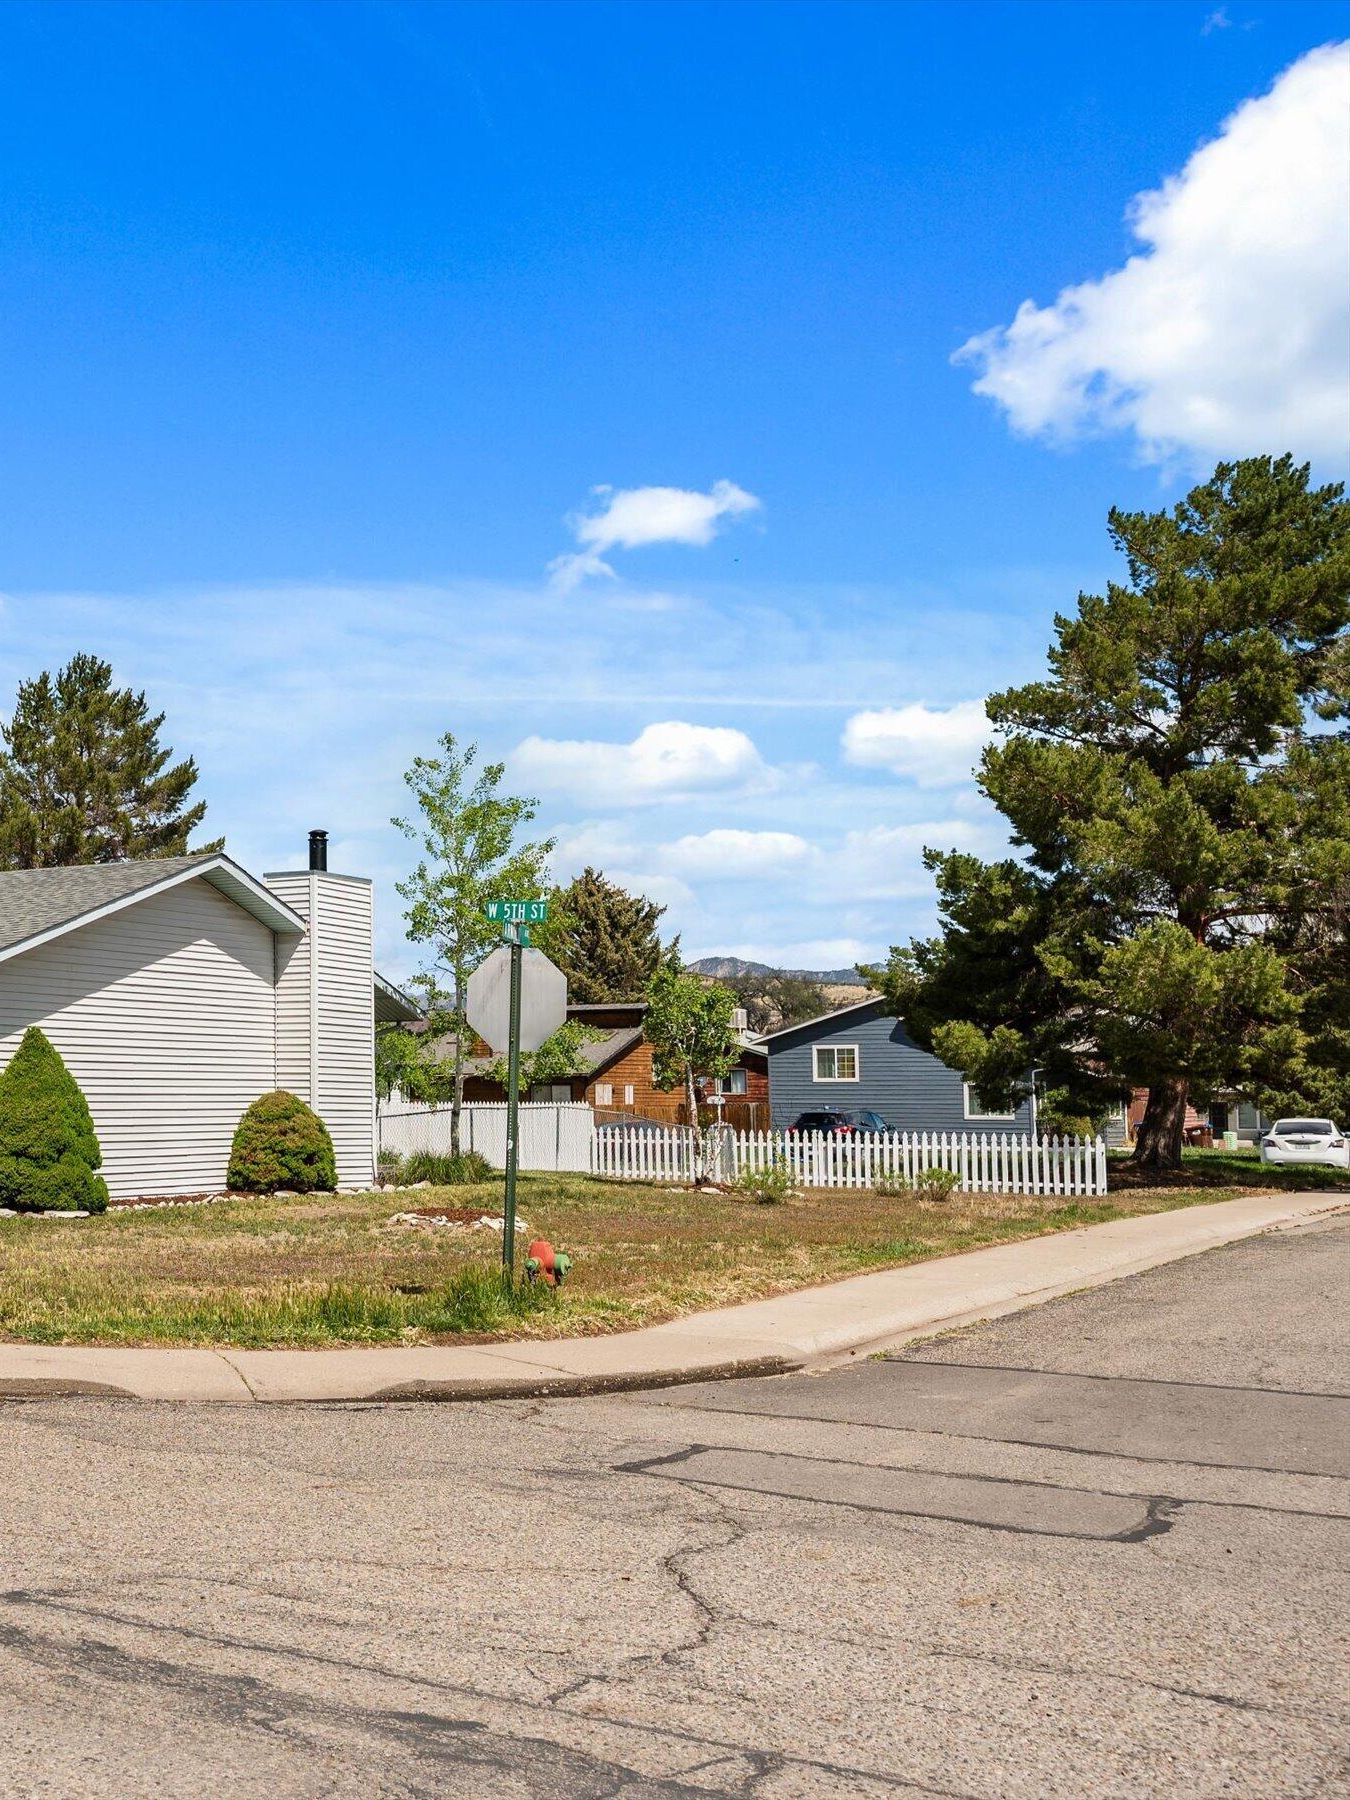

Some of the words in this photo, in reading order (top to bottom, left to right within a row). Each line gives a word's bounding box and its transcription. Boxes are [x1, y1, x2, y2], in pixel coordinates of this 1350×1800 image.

[488, 903, 498, 919] W
[503, 903, 526, 919] 5TH
[530, 903, 546, 919] ST
